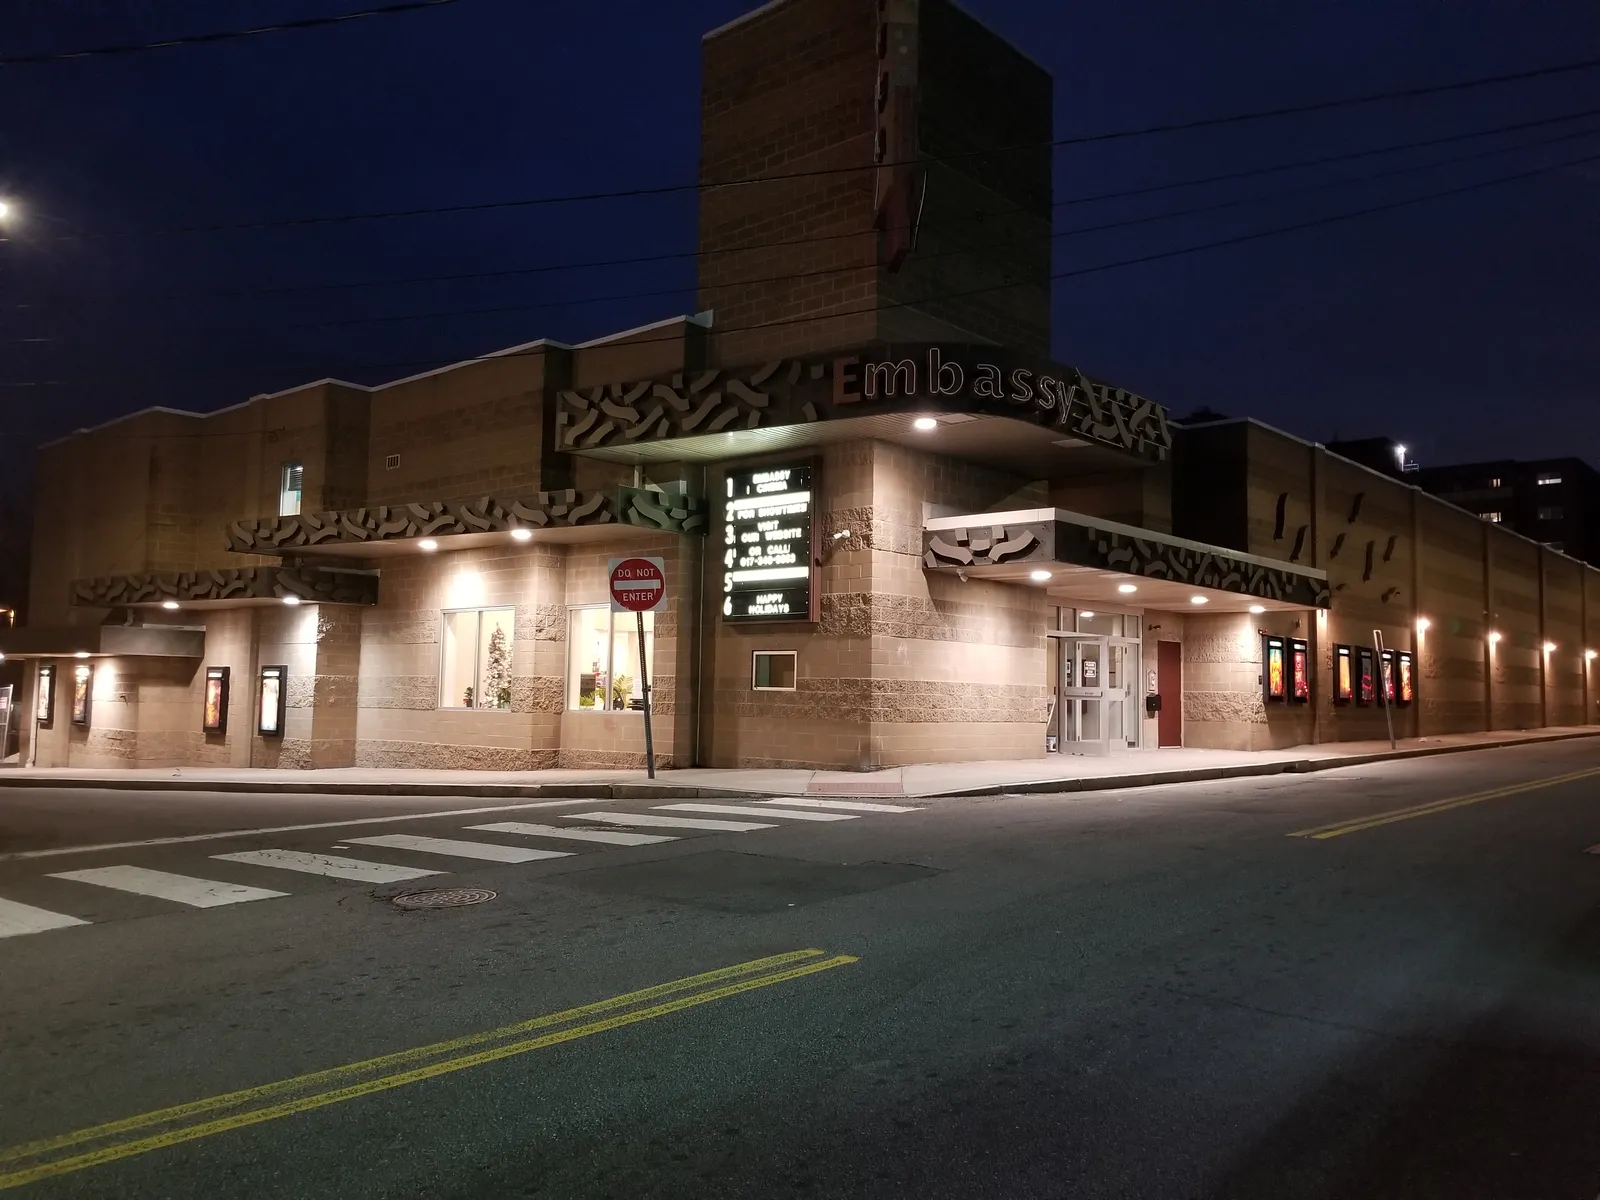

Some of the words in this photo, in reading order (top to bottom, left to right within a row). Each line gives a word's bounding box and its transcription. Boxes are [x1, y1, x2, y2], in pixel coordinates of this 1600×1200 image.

[833, 347, 1077, 424] Embassy
[727, 478, 733, 497] 1
[726, 502, 734, 521] 2
[725, 524, 733, 544] 3
[725, 549, 733, 568] 4
[617, 569, 631, 577] DO
[636, 568, 655, 577] NOT
[724, 572, 733, 592] 5
[623, 592, 654, 601] ENTER
[724, 596, 732, 615] 6
[756, 593, 783, 604] HAPPY
[748, 603, 790, 615] HOLIDAYS
